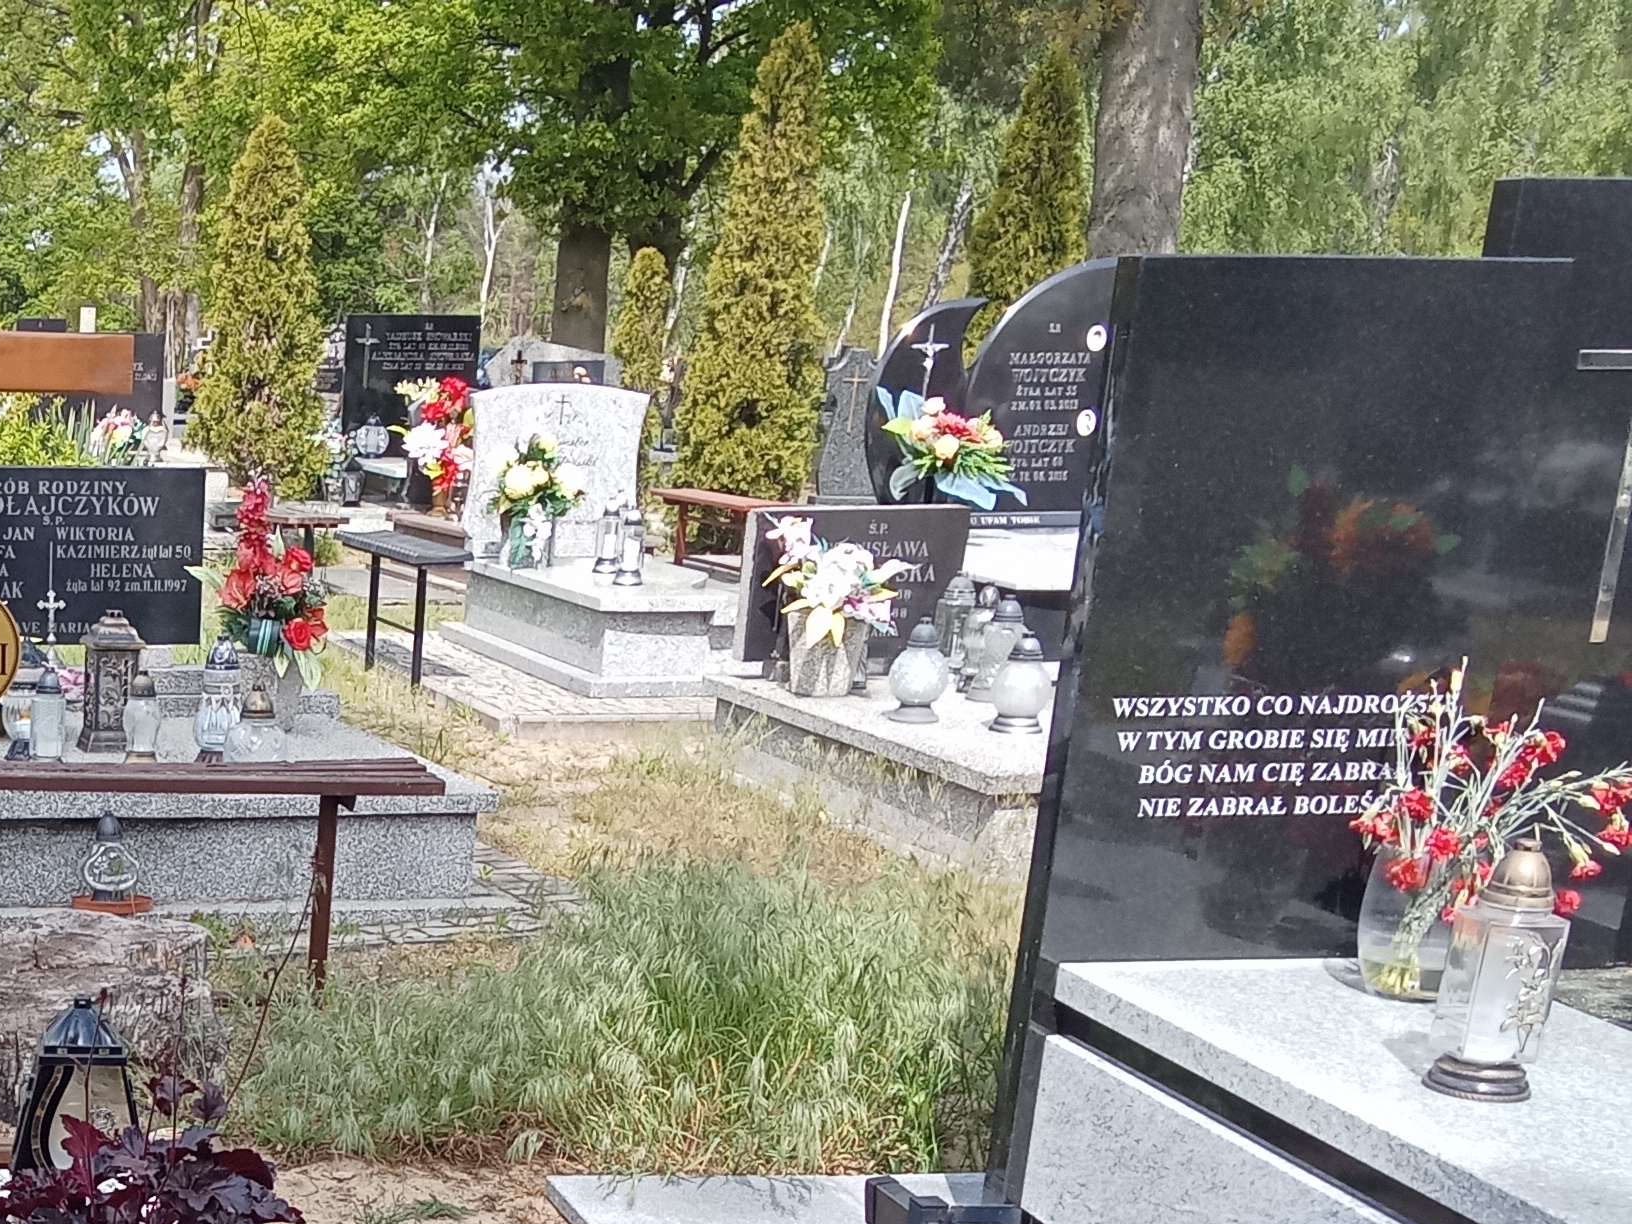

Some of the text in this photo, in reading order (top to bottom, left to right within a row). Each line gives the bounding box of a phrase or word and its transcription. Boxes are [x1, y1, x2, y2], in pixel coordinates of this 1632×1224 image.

[1009, 352, 1091, 366] MAŁGORZATA
[38, 480, 128, 496] RODZINY
[2, 526, 135, 541] JAN WIKTORIA
[56, 545, 140, 559] KAZIMIERZ
[90, 563, 155, 578] HELENA
[107, 580, 120, 592] 92
[1112, 696, 1251, 718] WSZYSTKO
[1256, 695, 1293, 716] CO
[1117, 731, 1143, 752] W
[1146, 730, 1204, 751] TYM
[1208, 729, 1305, 750] GROBIE
[1310, 728, 1351, 753] SIĘ
[1138, 760, 1193, 784] BÓG
[1197, 763, 1258, 784] NAM
[1262, 762, 1306, 787] CIĘ
[1137, 797, 1182, 818] NIE
[1186, 795, 1287, 817] ZABRAŁ
